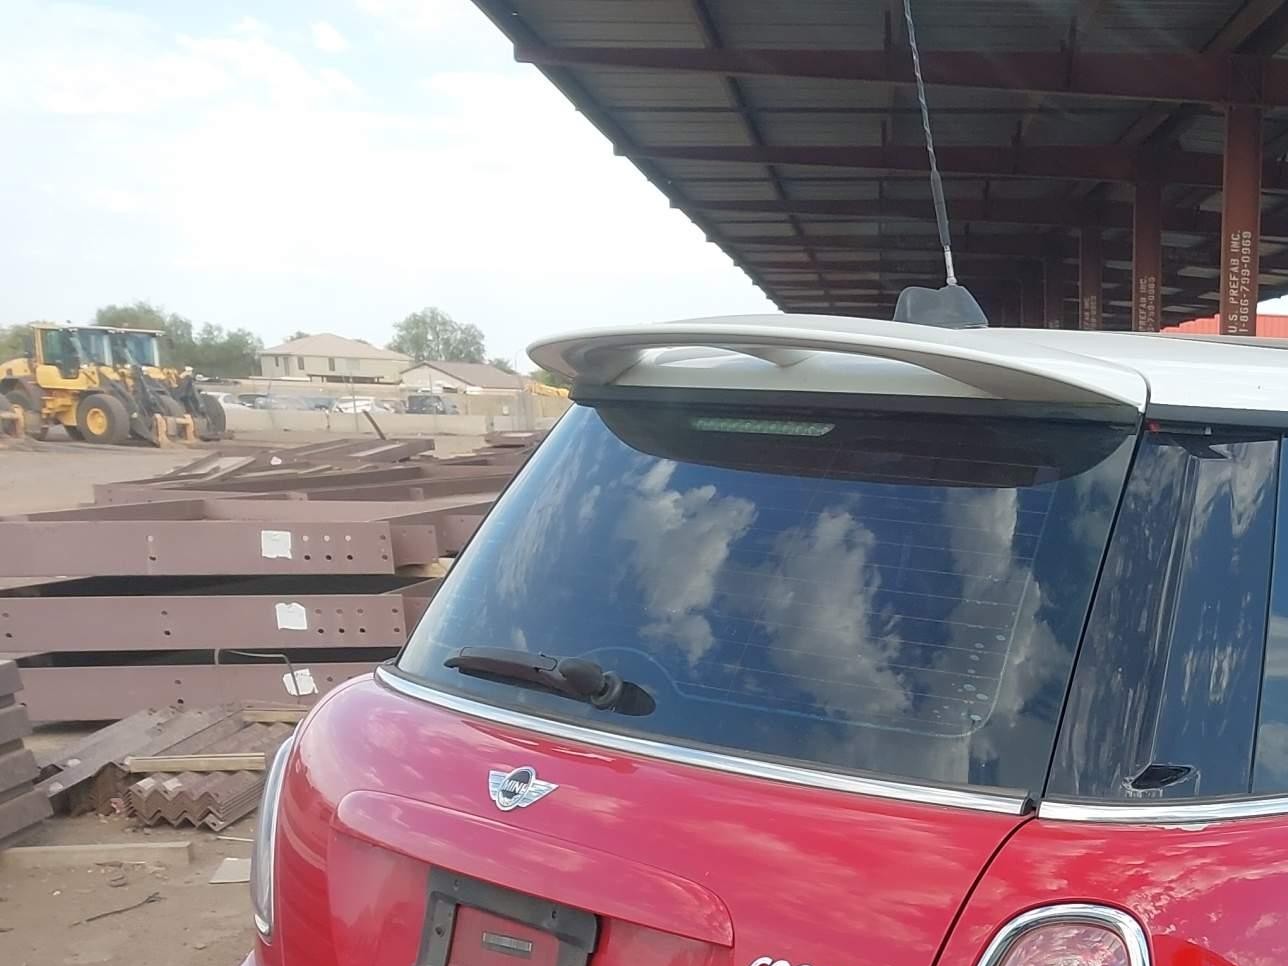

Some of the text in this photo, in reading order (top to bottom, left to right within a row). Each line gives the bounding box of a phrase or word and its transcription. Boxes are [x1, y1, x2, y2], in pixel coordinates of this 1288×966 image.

[1228, 230, 1241, 333] U.S. PREFAB INC.
[1239, 231, 1251, 332] 1-866-799-0969
